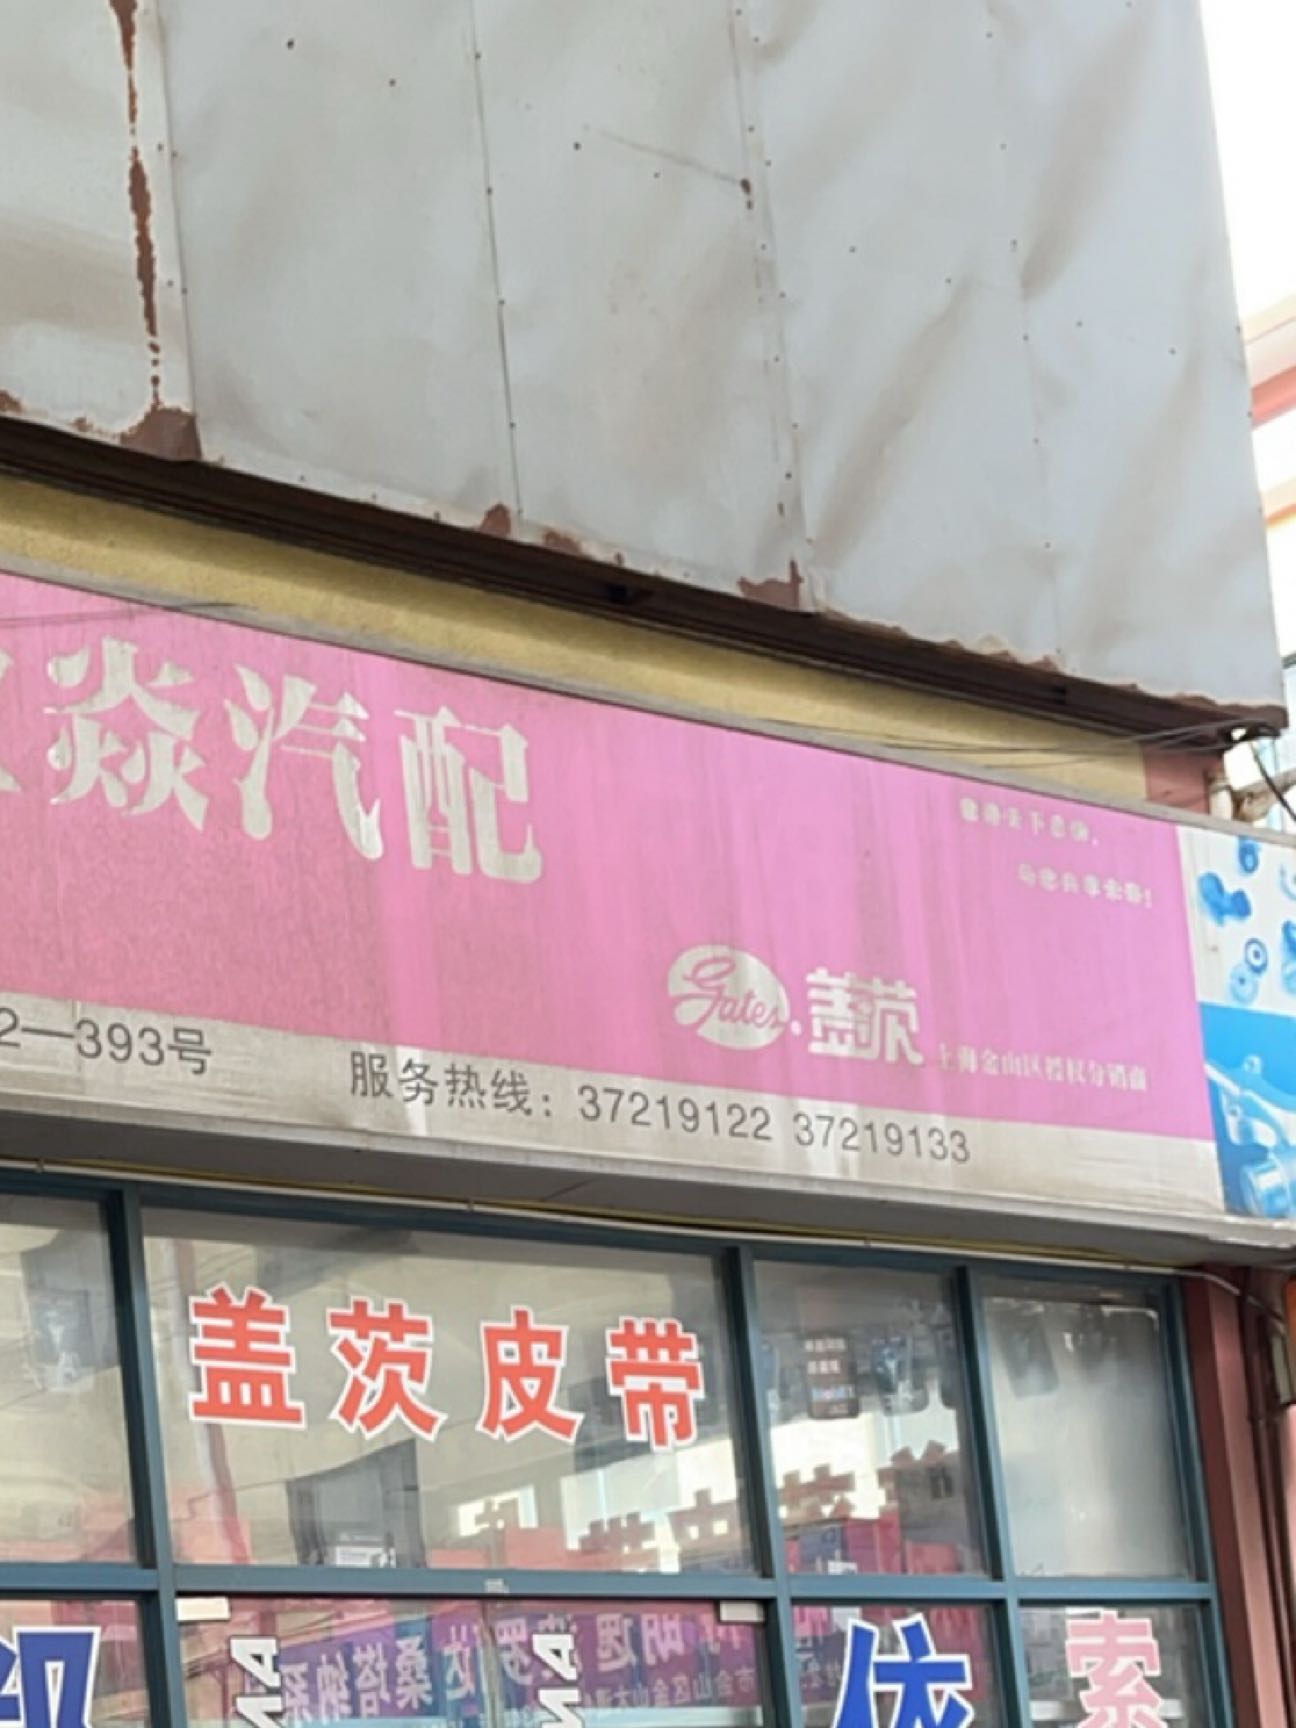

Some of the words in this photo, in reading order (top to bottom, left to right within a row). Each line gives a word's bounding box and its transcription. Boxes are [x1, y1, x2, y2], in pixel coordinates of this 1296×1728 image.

[669, 950, 791, 1045] Gates
[792, 1113, 971, 1164] 37219133
[188, 1285, 705, 1451] 盖茨皮带
